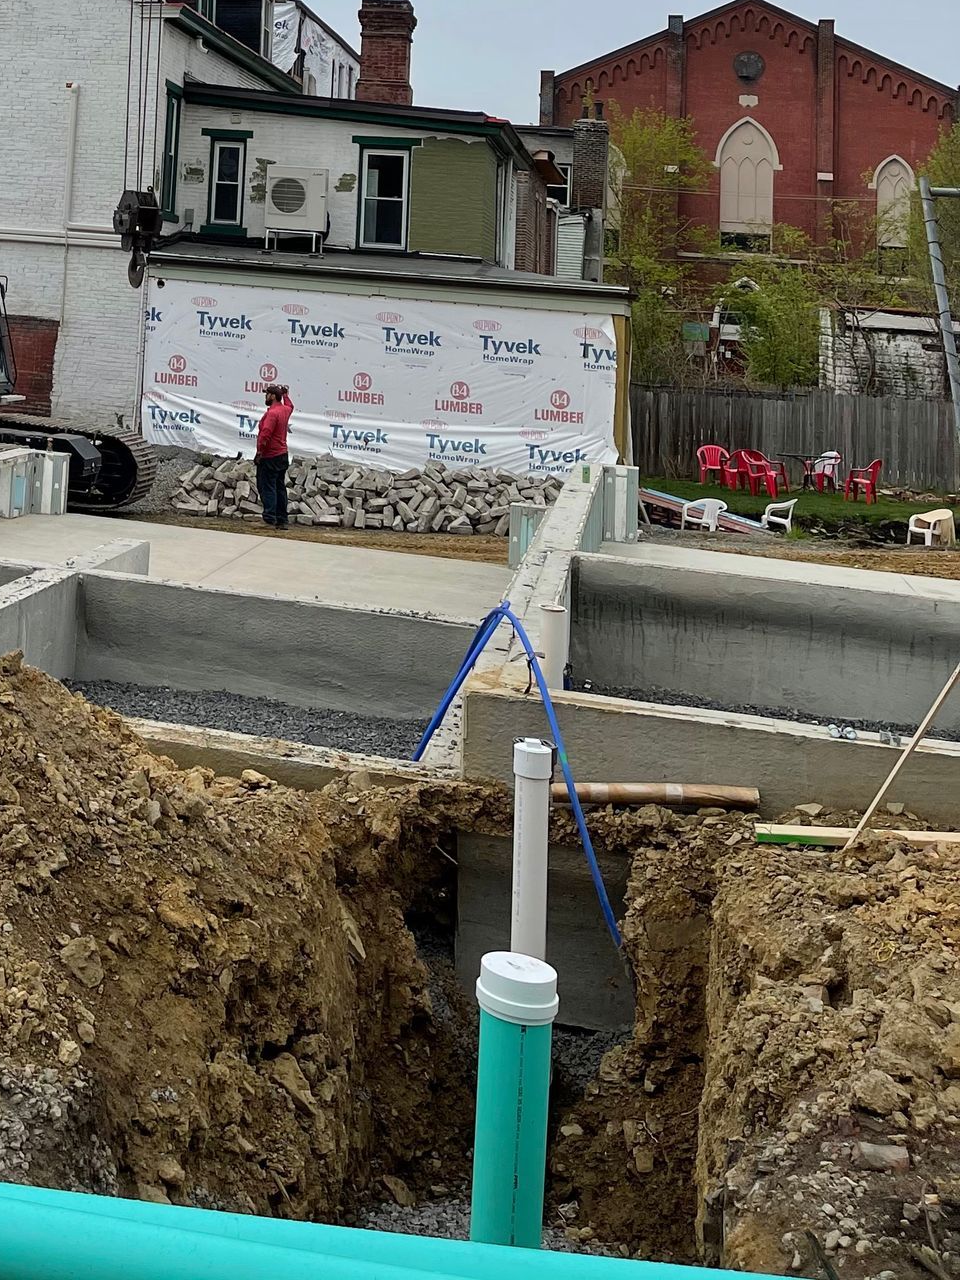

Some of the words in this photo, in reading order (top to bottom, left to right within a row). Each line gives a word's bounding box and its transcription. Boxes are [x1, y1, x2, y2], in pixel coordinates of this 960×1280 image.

[197, 311, 252, 330] Tyvek
[200, 329, 245, 340] HomeWrap
[288, 319, 345, 338] Tyvek
[291, 337, 339, 348] HomeWrap
[382, 327, 442, 346] Tyvek
[385, 345, 435, 356] HomeWrap
[480, 335, 540, 355] Tyvek
[483, 354, 534, 365] HomeWrap
[155, 372, 197, 387] LUMBER
[338, 390, 384, 405] LUMBER
[435, 400, 483, 414] LUMBER
[148, 406, 201, 424] Tyvek
[534, 409, 584, 424] LUMBER
[330, 424, 388, 443] Tyvek
[333, 442, 381, 453] HomeWrap
[426, 434, 487, 454] Tyvek
[429, 452, 480, 464] HomeWrap
[526, 443, 587, 464] Tyvek
